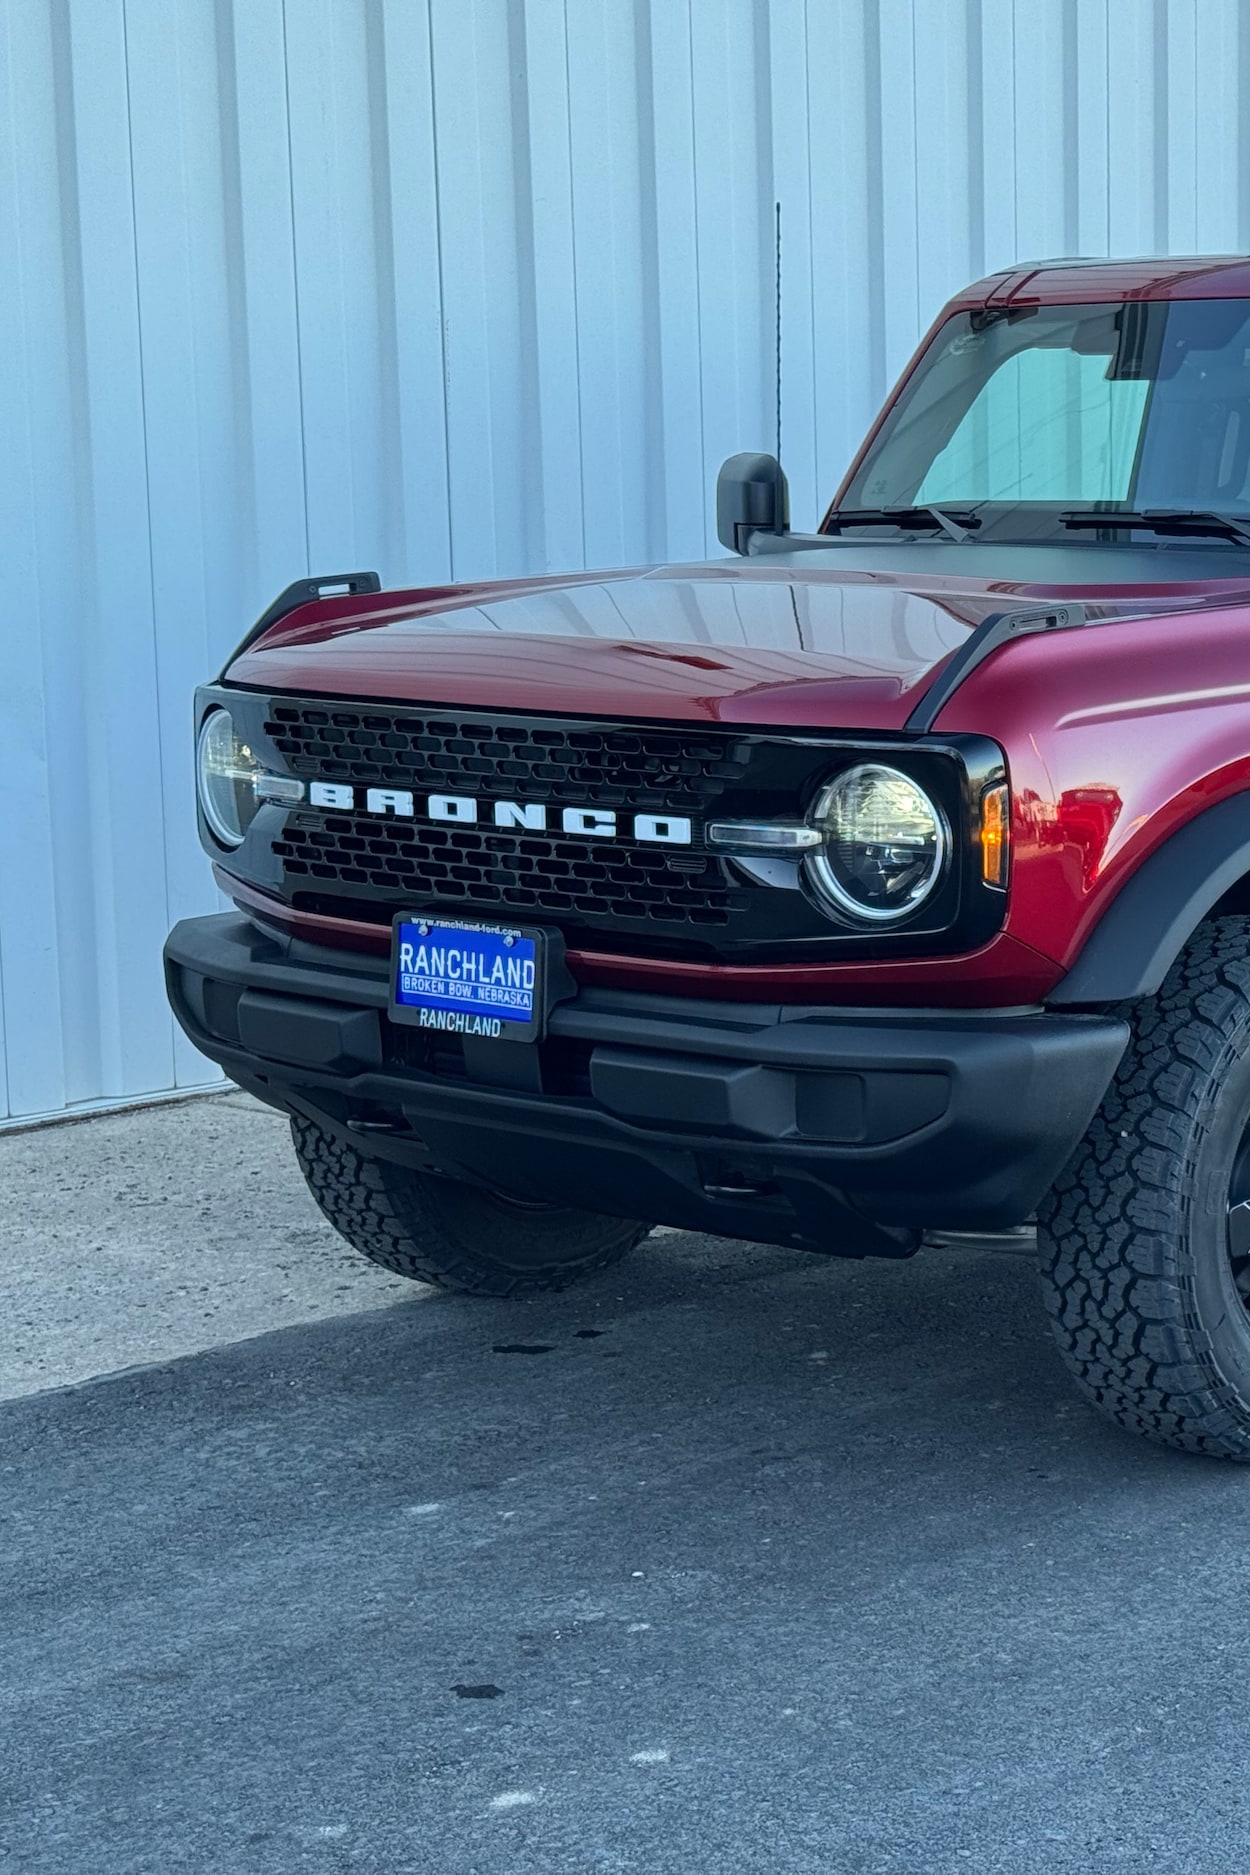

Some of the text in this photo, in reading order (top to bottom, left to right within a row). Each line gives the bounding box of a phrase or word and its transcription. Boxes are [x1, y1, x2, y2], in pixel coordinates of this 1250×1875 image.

[309, 781, 692, 845] BRONCO
[411, 917, 521, 938] www.ranchland-ford.com
[400, 943, 535, 989] RANCHLAND
[404, 977, 445, 994] BROKEN
[478, 987, 530, 1006] NEBRASKA
[419, 1007, 501, 1038] RANCHLAND
